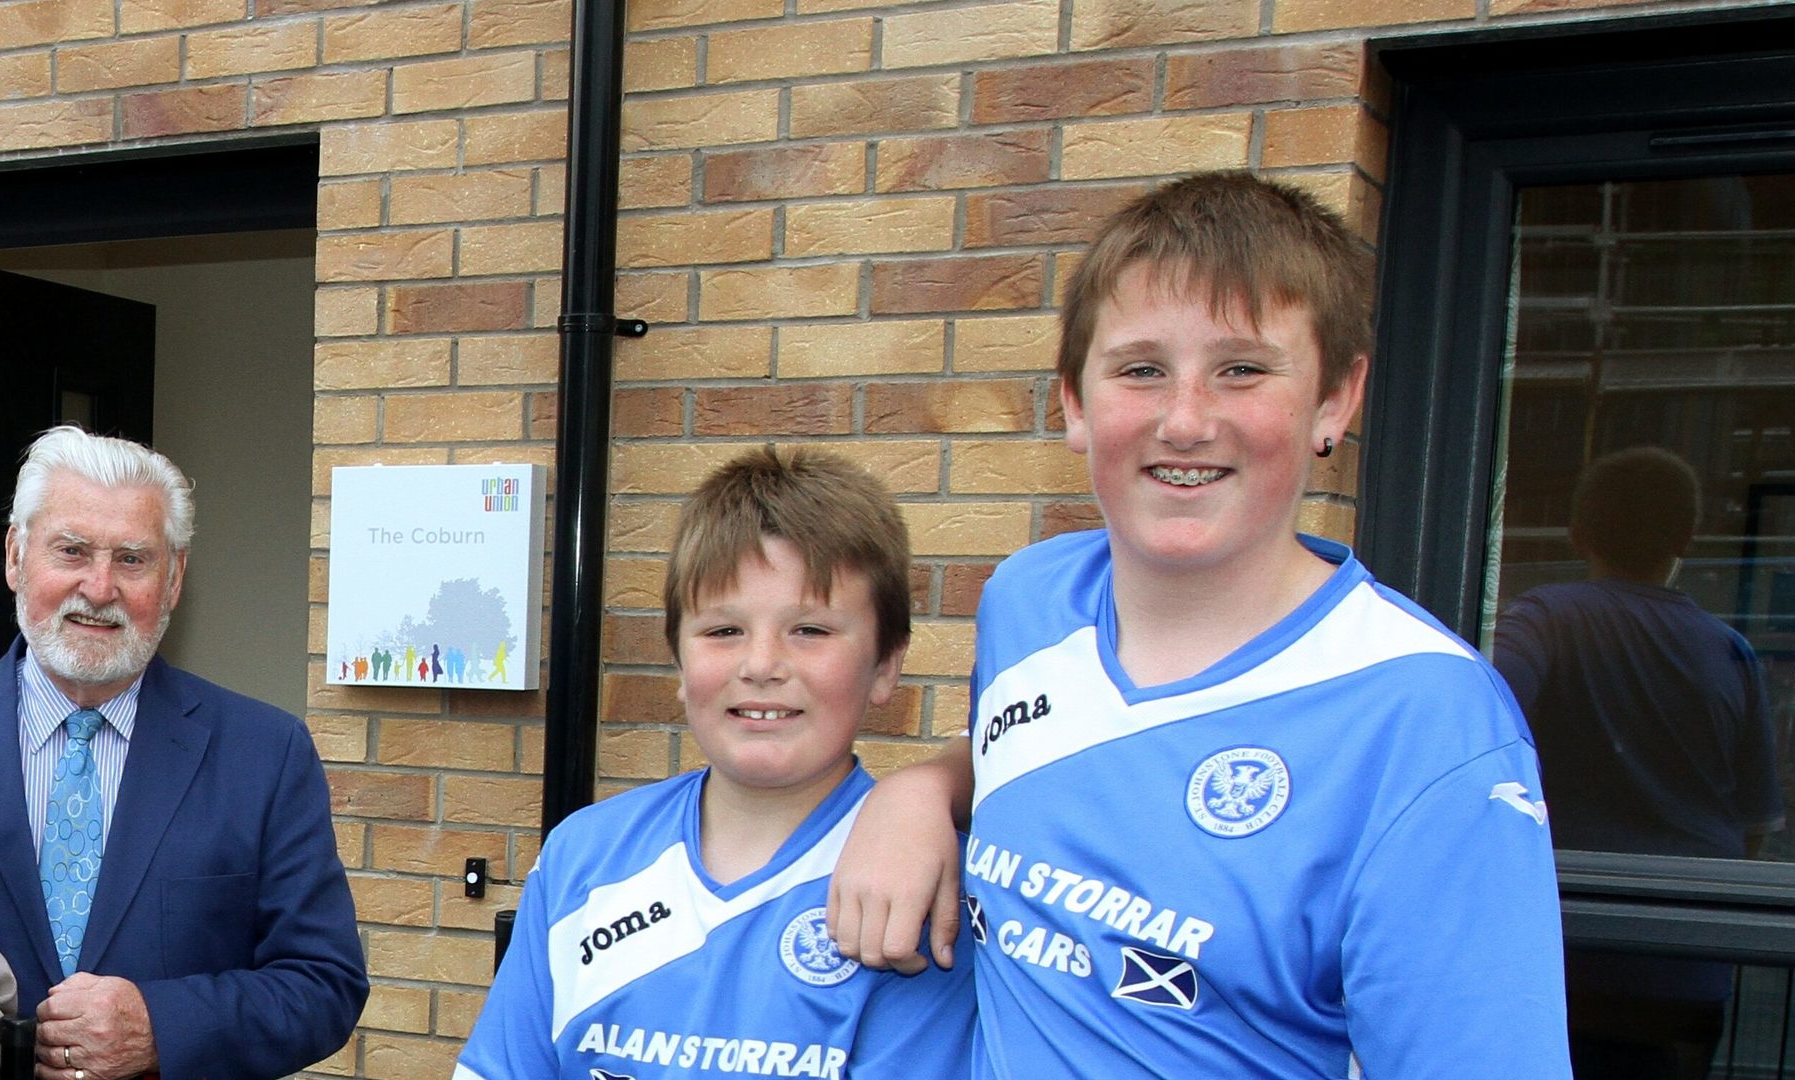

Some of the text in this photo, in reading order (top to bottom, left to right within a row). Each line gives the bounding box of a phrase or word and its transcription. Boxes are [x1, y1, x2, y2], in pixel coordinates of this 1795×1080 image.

[482, 477, 519, 495] urban
[485, 495, 519, 512] union
[368, 527, 485, 545] The Coburn
[1190, 751, 1250, 801] JOHNSTONE
[1253, 751, 1287, 799] FOOTBALL
[1213, 822, 1235, 833] 1884
[1245, 804, 1278, 831] CLUB
[965, 834, 1215, 960] LAN STORRAR
[997, 919, 1093, 978] CARS
[577, 1022, 682, 1067] ALAN
